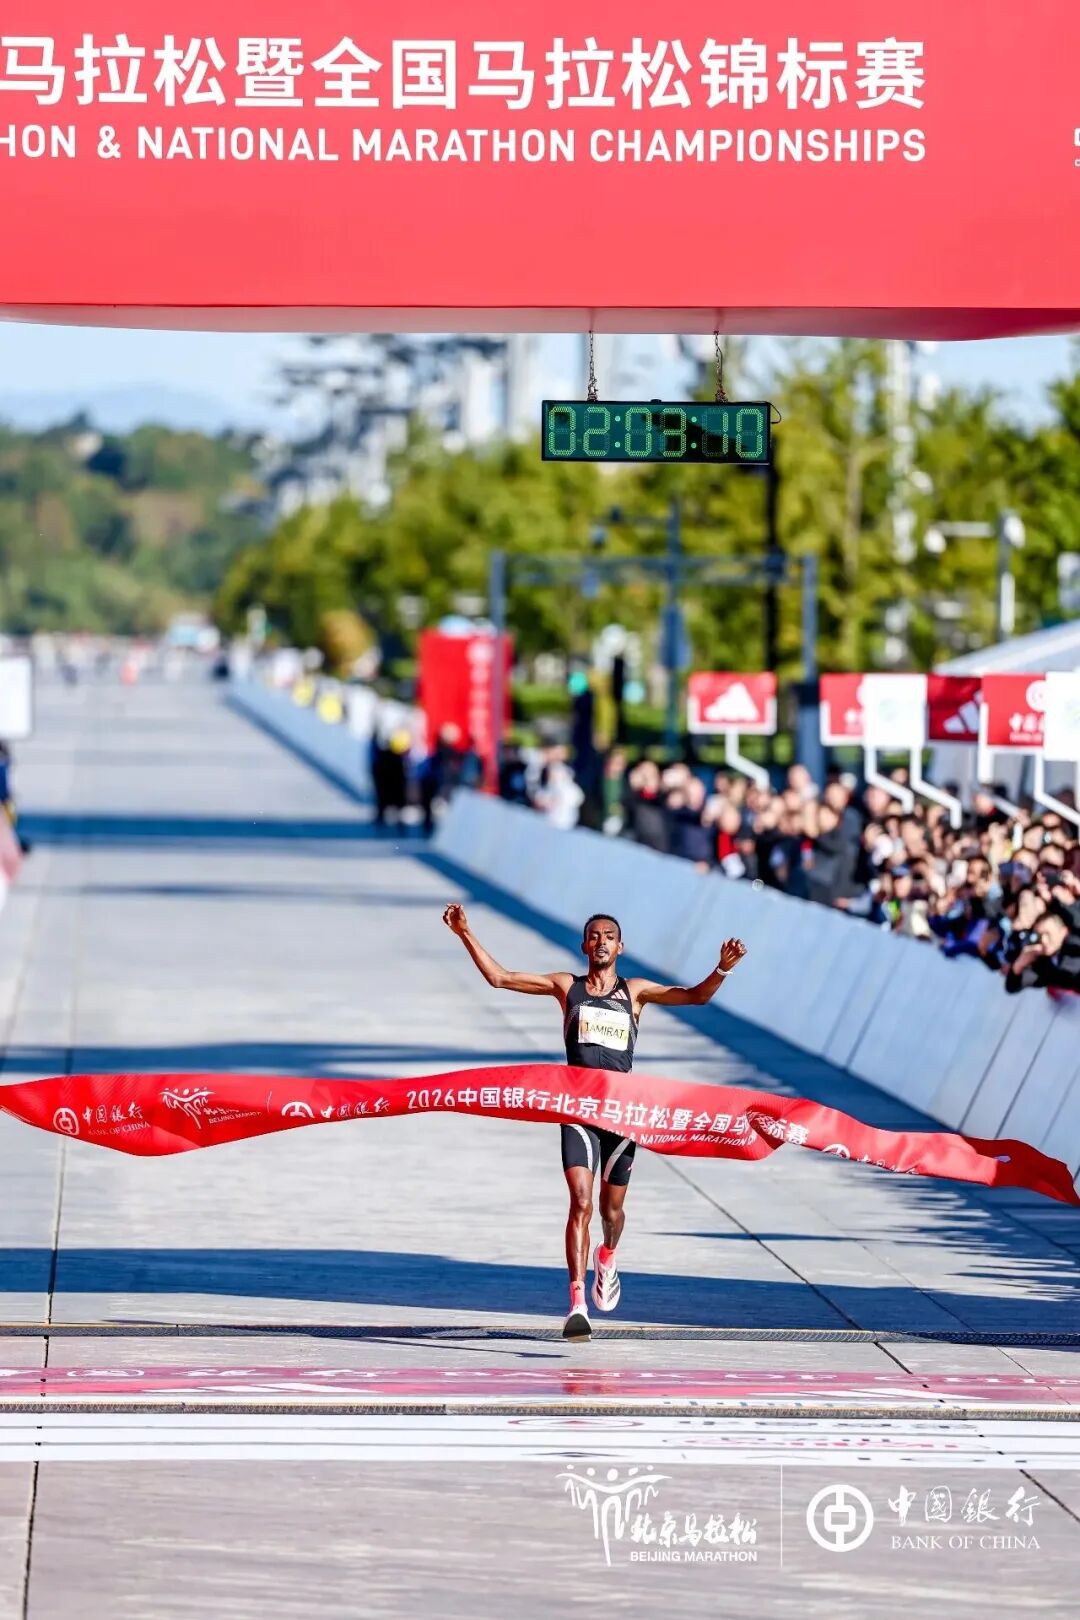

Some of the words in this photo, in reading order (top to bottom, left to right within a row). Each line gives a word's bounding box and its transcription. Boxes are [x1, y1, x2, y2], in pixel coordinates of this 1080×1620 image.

[0, 33, 926, 110] 马拉松暨全国马拉松锦标赛
[97, 125, 121, 159] &
[138, 126, 339, 161] NATIONAL
[352, 127, 575, 162] MARATHON
[590, 129, 926, 162] CHAMPIONSHIPS
[549, 406, 764, 458] 02:03:10
[122, 1121, 151, 1133] CHINA
[640, 1133, 687, 1145] NATIONAL
[689, 1133, 748, 1147] MARATHON
